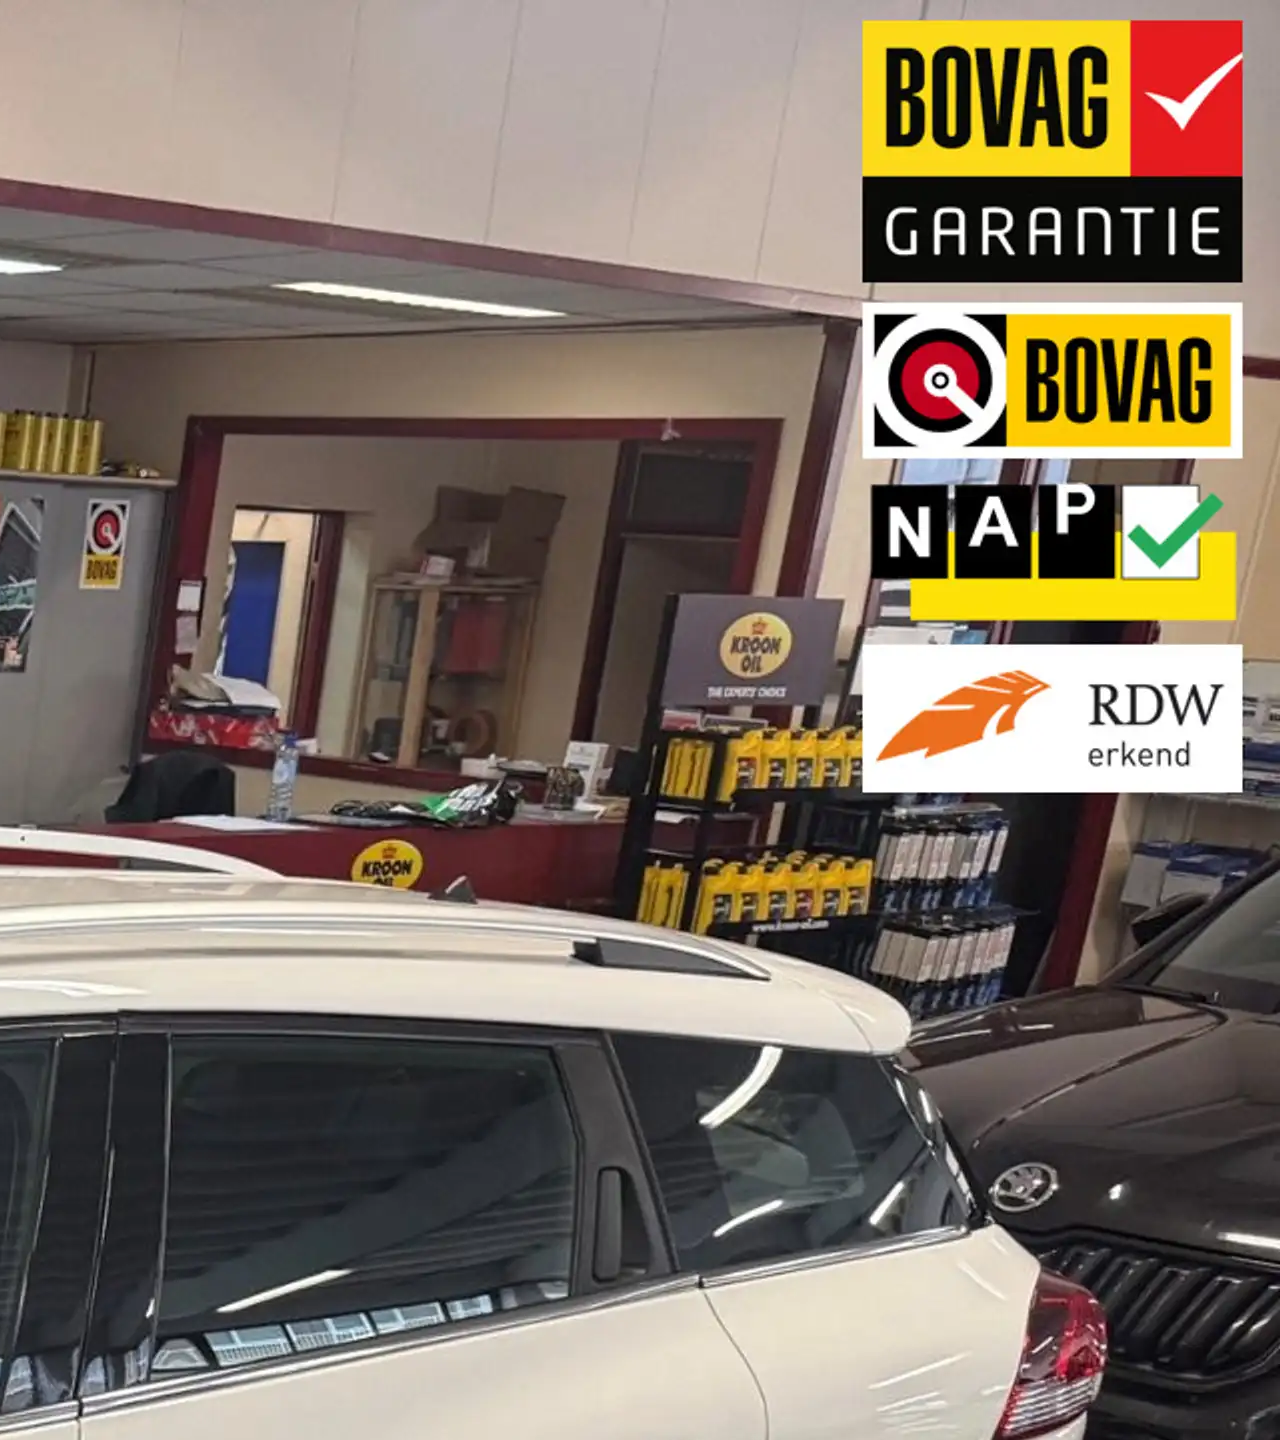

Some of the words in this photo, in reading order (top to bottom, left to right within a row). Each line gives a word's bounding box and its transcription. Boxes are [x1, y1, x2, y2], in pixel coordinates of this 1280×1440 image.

[86, 559, 118, 581] BOVAG
[730, 636, 782, 655] KROON
[741, 655, 764, 673] OIL
[362, 859, 414, 877] KROON
